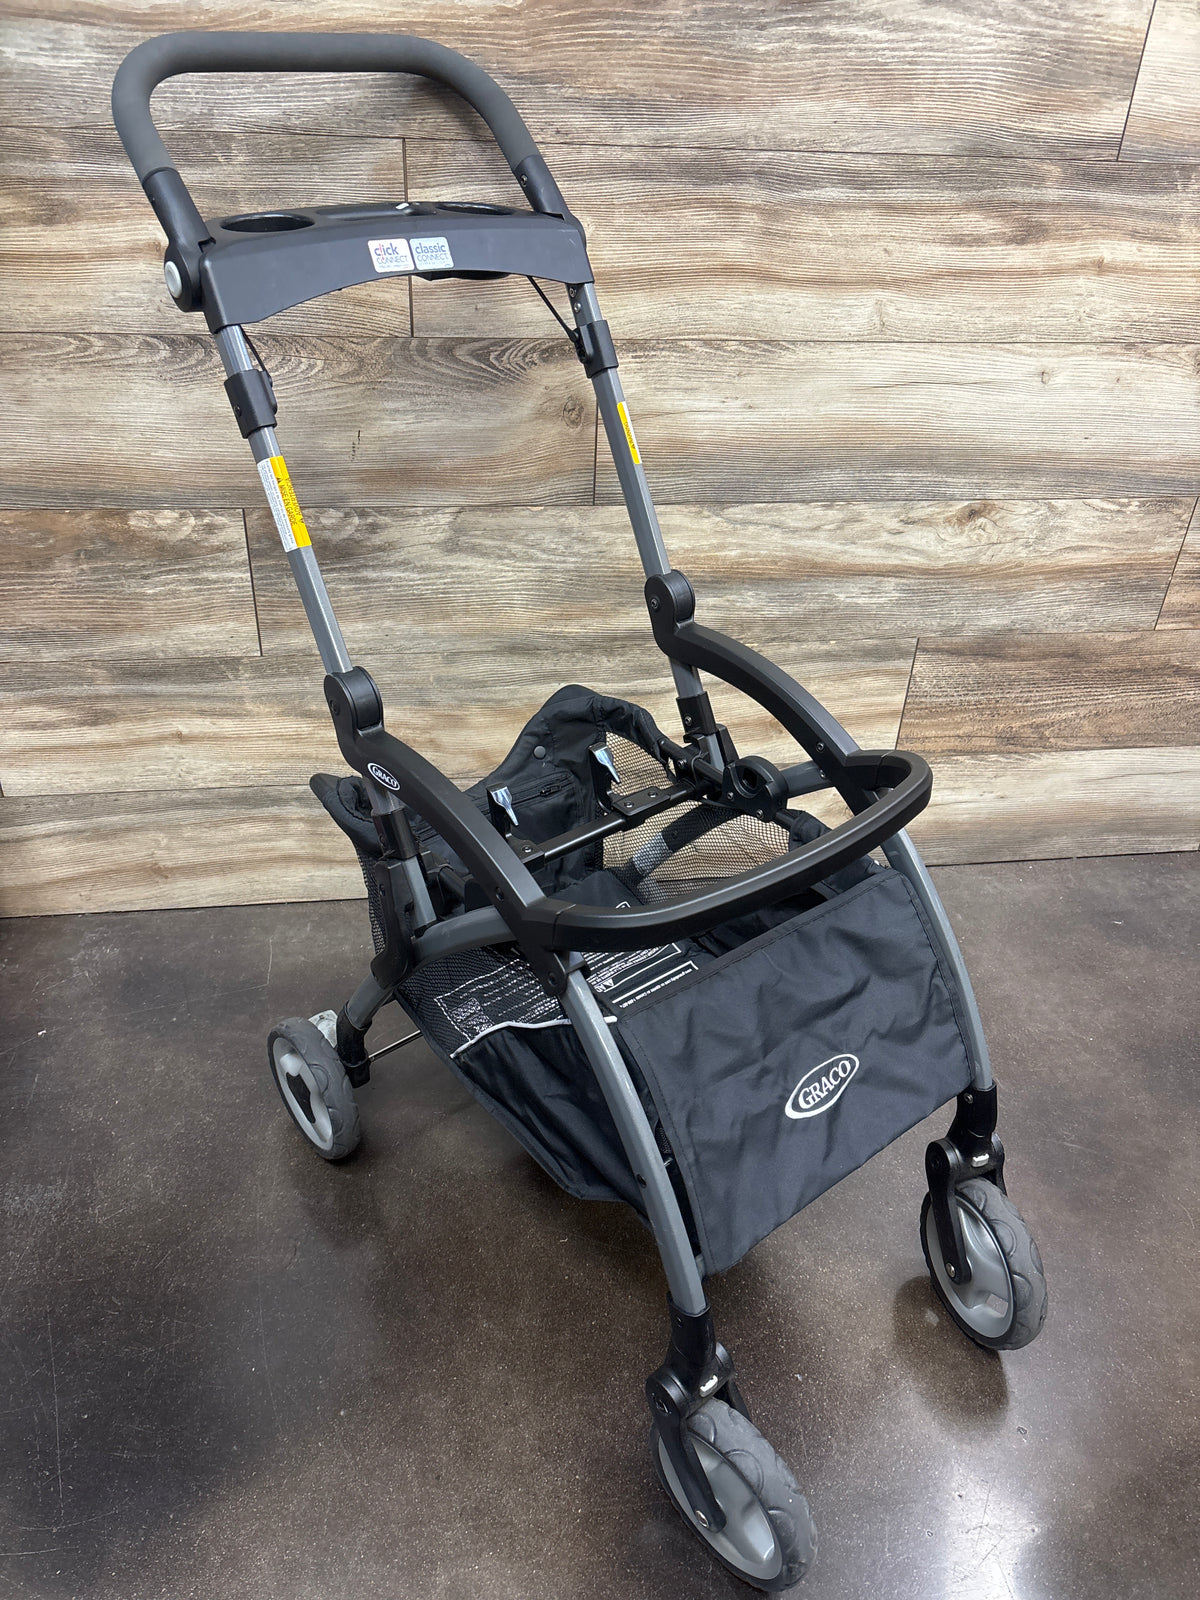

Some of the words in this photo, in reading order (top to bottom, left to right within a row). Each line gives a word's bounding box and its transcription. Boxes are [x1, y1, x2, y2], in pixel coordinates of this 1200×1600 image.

[374, 242, 399, 256] click
[415, 242, 446, 254] classic
[416, 253, 449, 262] CONNECT
[372, 767, 397, 787] GRACO
[798, 1060, 851, 1109] GRACO
